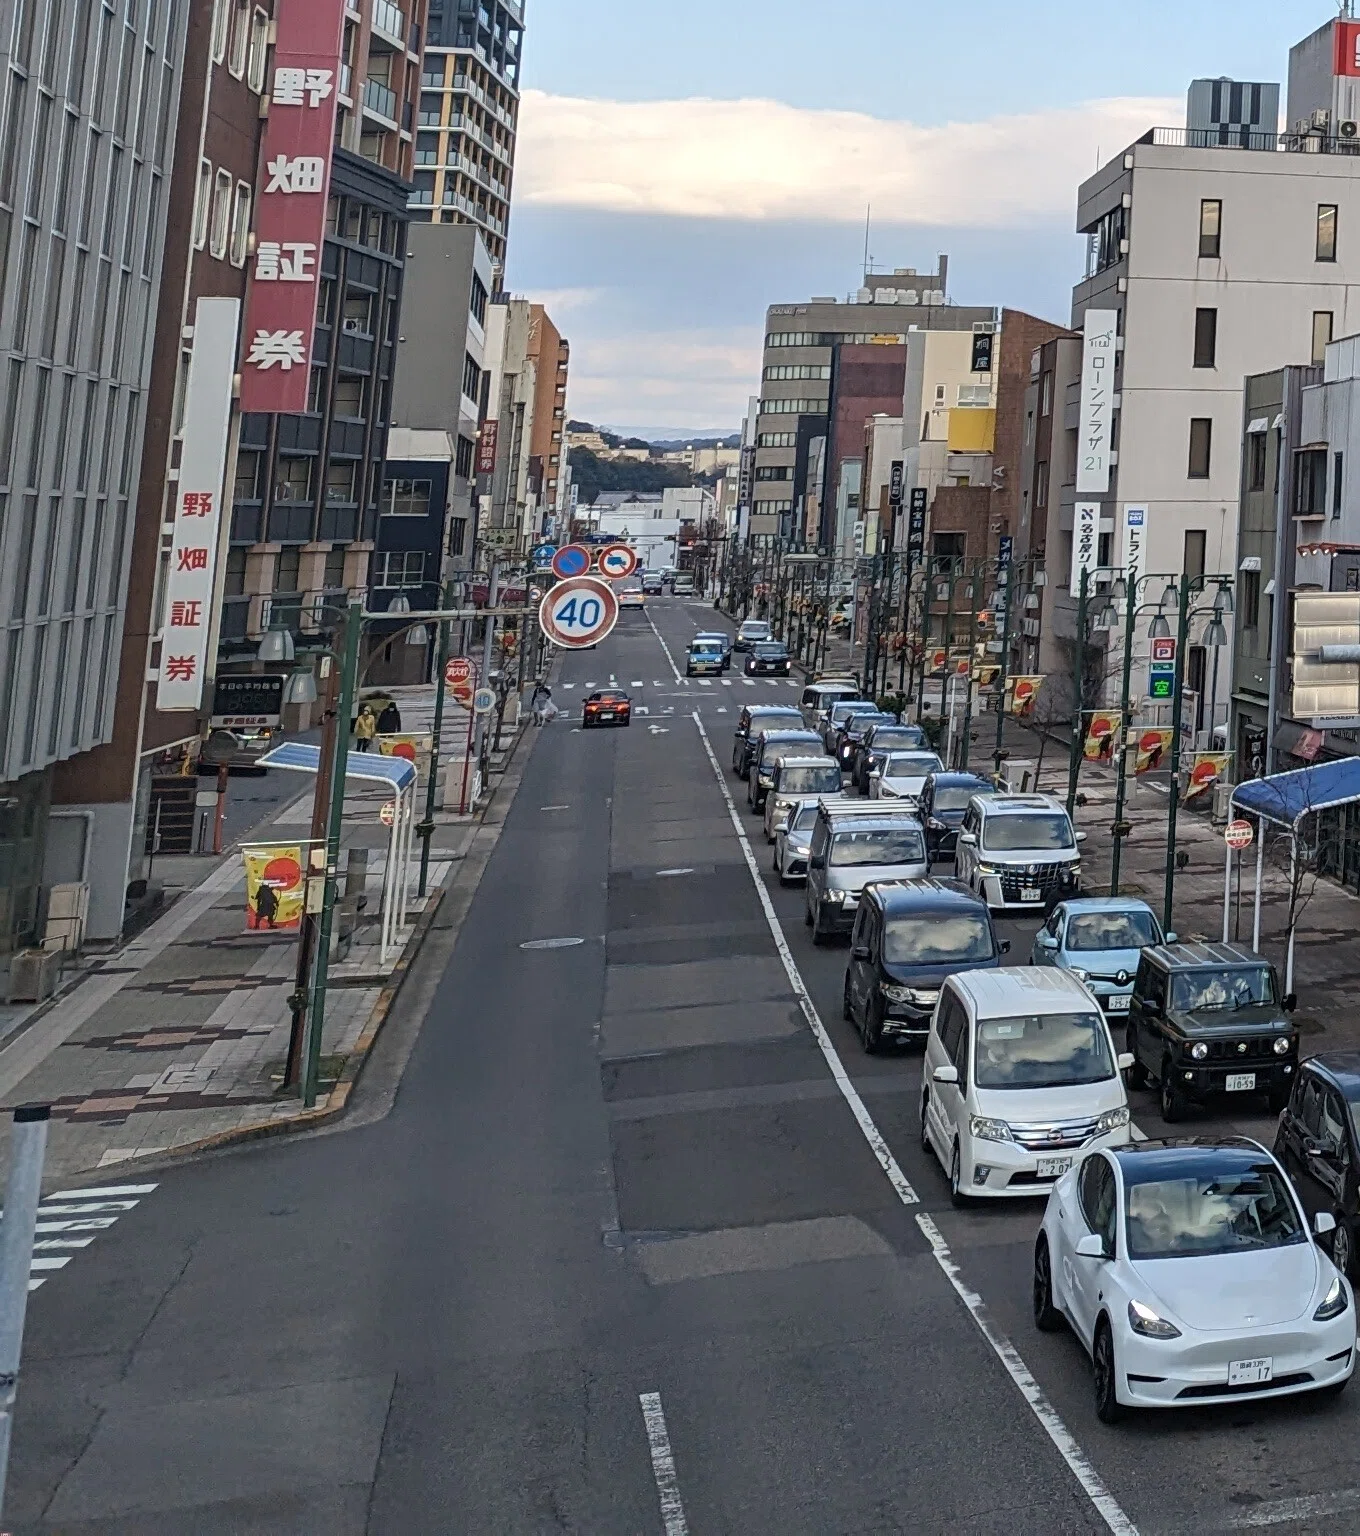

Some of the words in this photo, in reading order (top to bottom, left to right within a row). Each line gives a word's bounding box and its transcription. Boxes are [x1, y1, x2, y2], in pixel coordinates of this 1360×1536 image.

[245, 67, 333, 370] 野畑証券
[1078, 524, 1094, 564] 名古屋リ
[166, 493, 212, 682] 野畑証券
[556, 598, 600, 628] 40
[1159, 648, 1169, 656] P
[1154, 680, 1169, 695] 空
